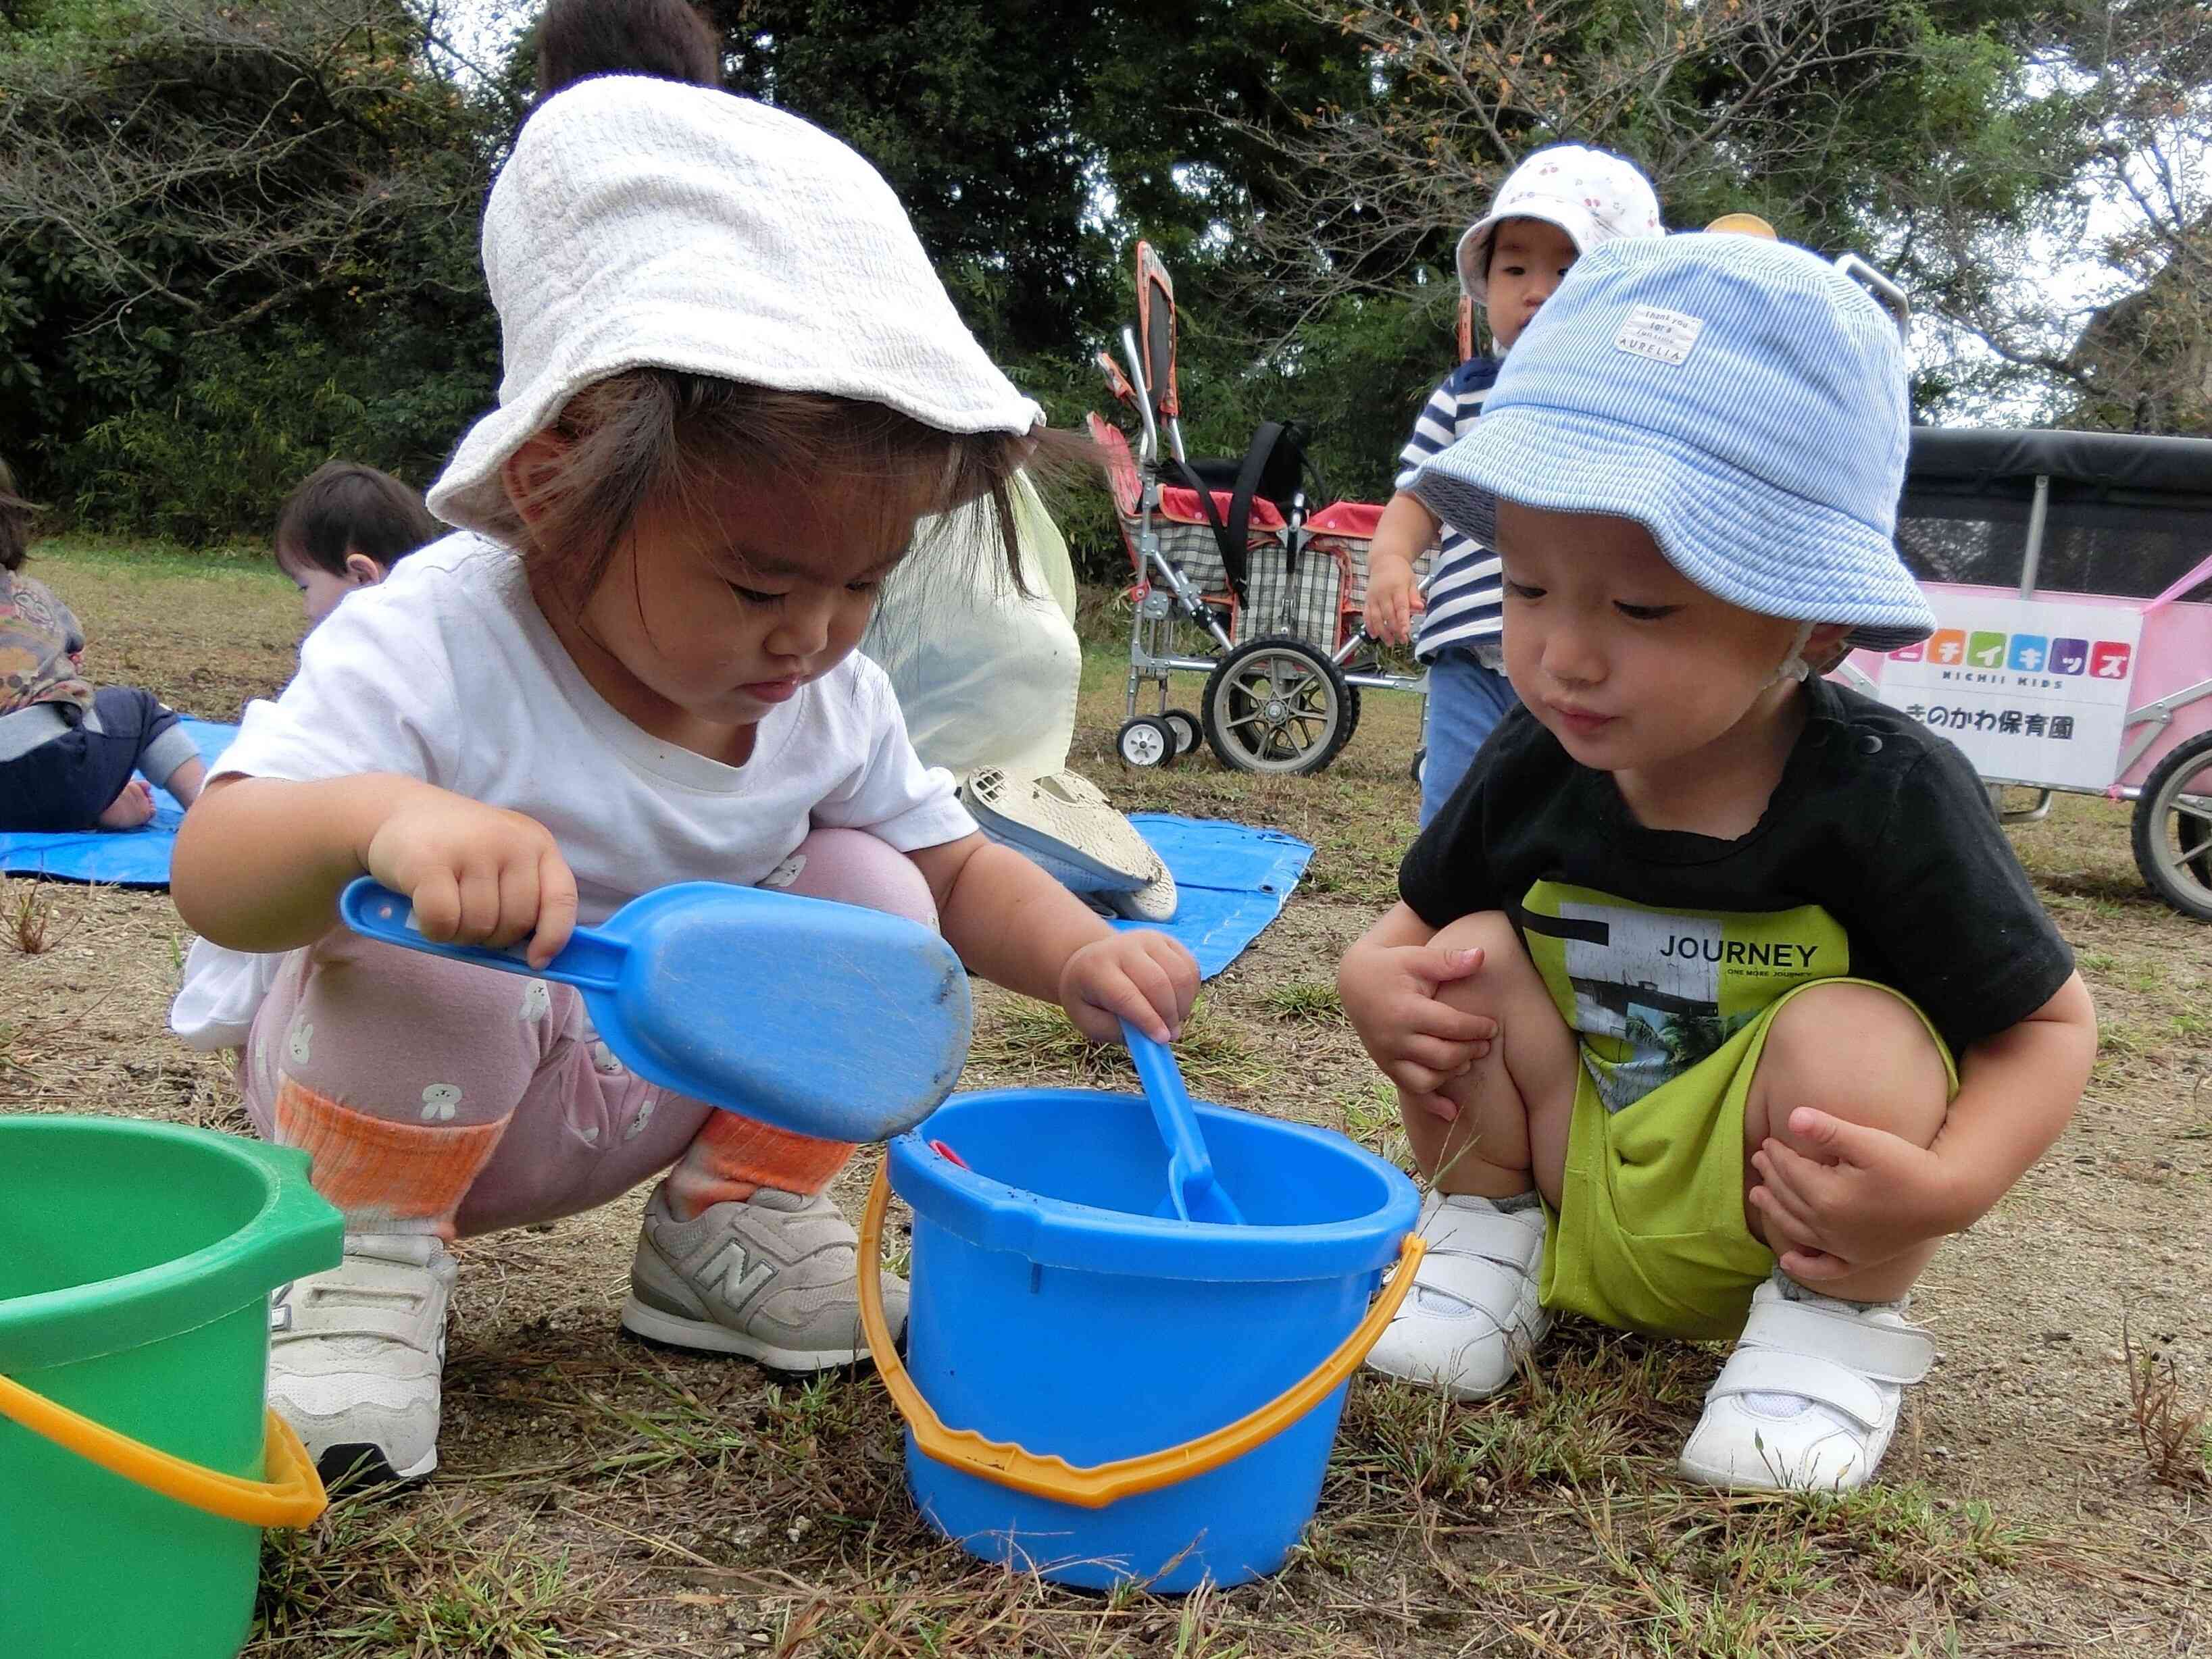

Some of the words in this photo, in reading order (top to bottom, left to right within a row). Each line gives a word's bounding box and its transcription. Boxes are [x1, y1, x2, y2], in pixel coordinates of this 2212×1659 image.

[1671, 319, 1688, 329] you
[1619, 338, 1682, 360] AURELIA
[2017, 677, 2063, 690] KIDS
[1659, 935, 1818, 968] JOURNEY
[1727, 968, 1744, 976] ONE
[1746, 969, 1769, 977] MORE
[1772, 970, 1813, 978] JOURNEY
[693, 1237, 780, 1312] N
